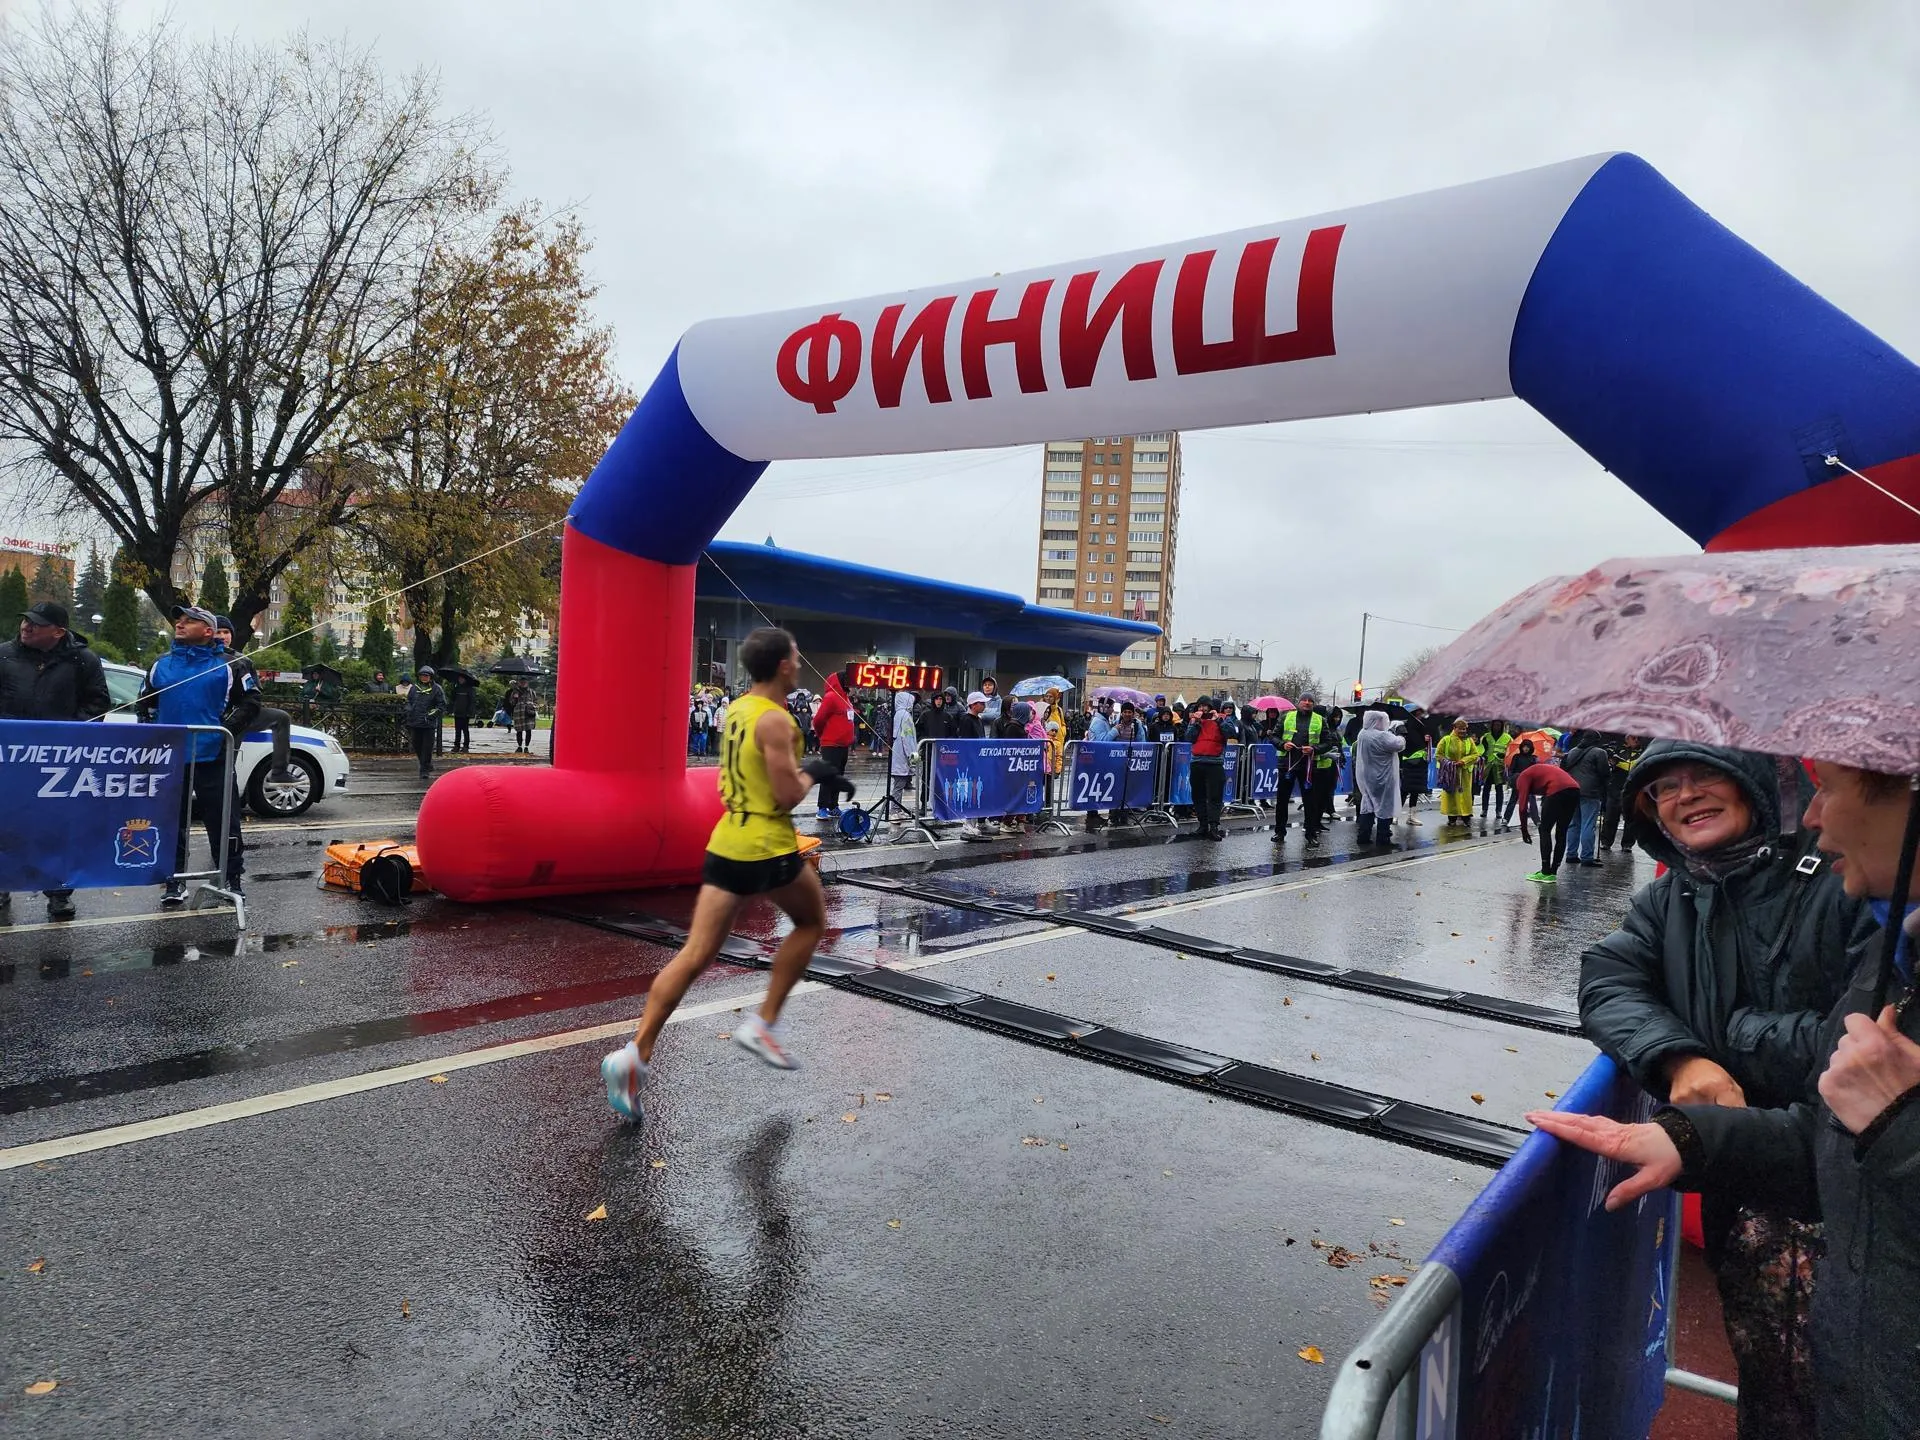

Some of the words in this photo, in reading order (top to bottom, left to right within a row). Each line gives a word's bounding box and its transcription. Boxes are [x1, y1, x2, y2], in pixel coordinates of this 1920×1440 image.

[775, 223, 1348, 415] ФИНИШ
[979, 745, 1041, 757] ЛЕГКОАТЛЕТИЧЕСКИЙ
[1109, 748, 1154, 758] ЛЕГКОАЕТИЧЕСКИЙ
[1076, 772, 1115, 803] 242
[1254, 768, 1279, 793] 242
